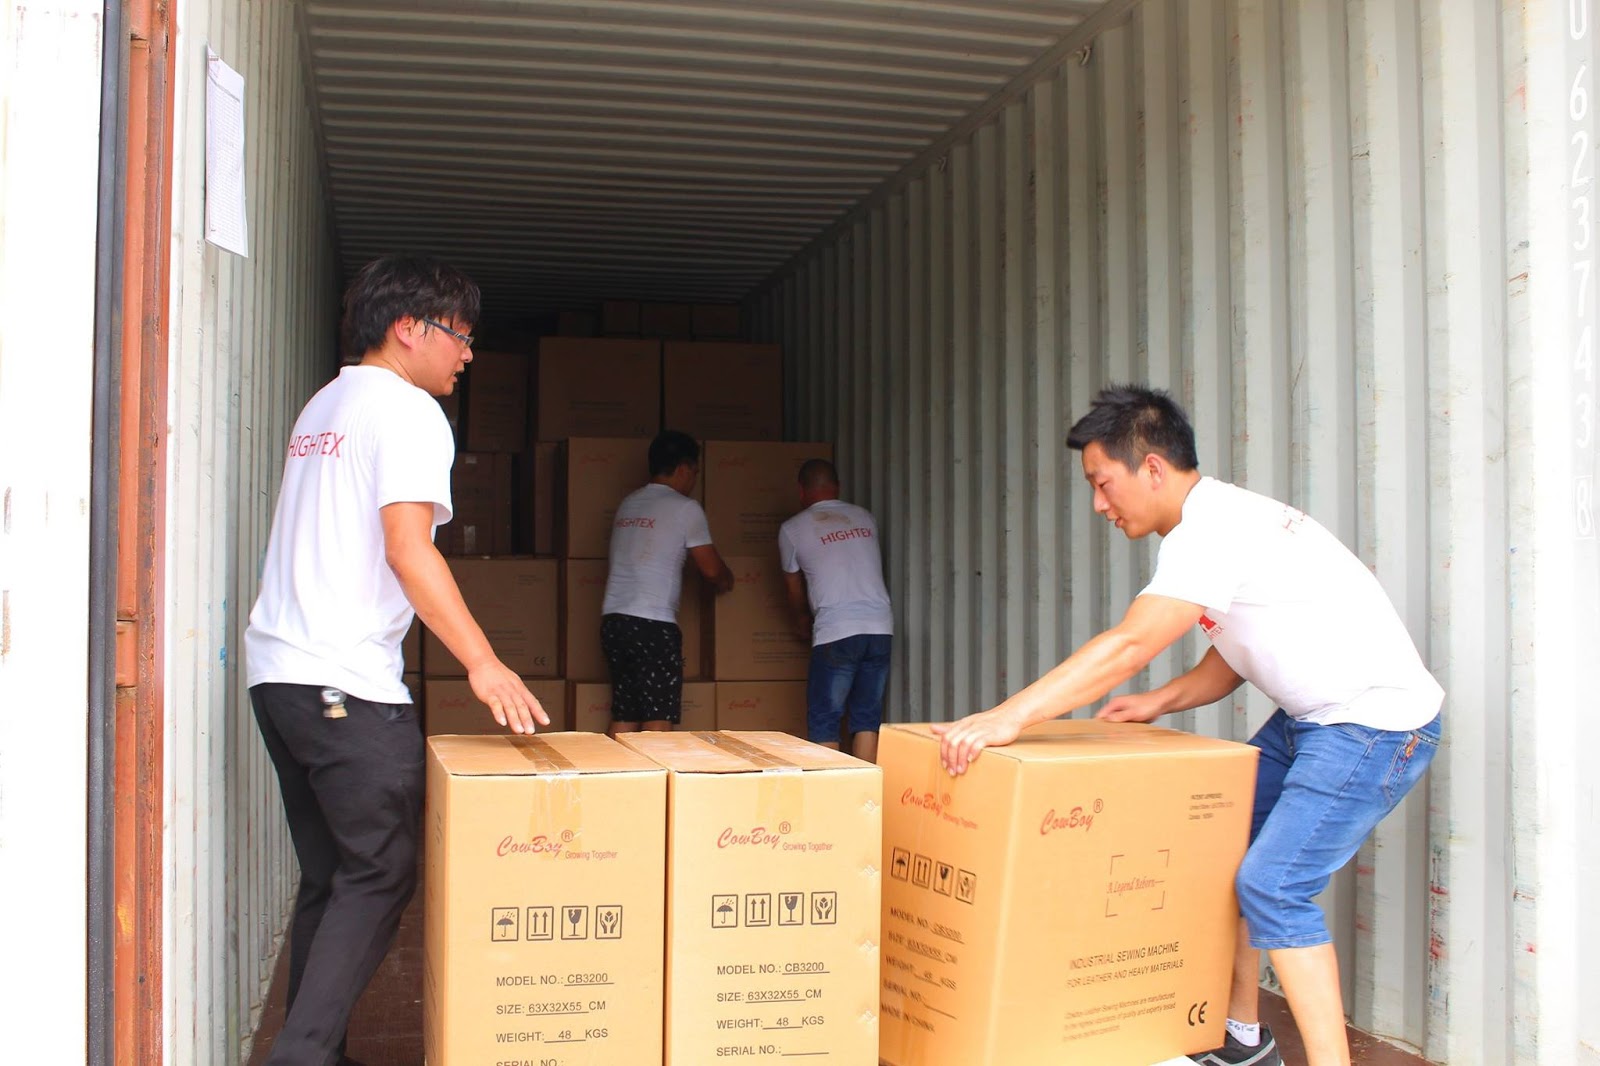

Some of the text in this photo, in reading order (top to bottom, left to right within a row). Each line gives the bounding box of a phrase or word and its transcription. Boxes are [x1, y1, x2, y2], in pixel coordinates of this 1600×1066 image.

[289, 432, 345, 458] HIGHTEX
[820, 527, 874, 545] HIGHTEX
[565, 849, 618, 861] Growing Together
[1116, 947, 1146, 962] SEWING
[1147, 941, 1180, 957] MACHINE
[716, 965, 756, 975] MODEL
[784, 961, 825, 973] CB3200
[1114, 969, 1127, 980] AND
[1128, 965, 1149, 977] HEAVY
[1150, 959, 1184, 974] MATERIALS
[496, 976, 537, 987] MODEL
[567, 972, 609, 984] CB3200
[716, 989, 822, 1002] SIZE: 63X32X55 CM
[496, 1000, 606, 1015] SIZE: 63X32X55 CM
[716, 1015, 825, 1029] WEIGHT: 48 KGS
[496, 1028, 609, 1043] WEIGHT: 48 KGS
[716, 1046, 756, 1057] SERIAL
